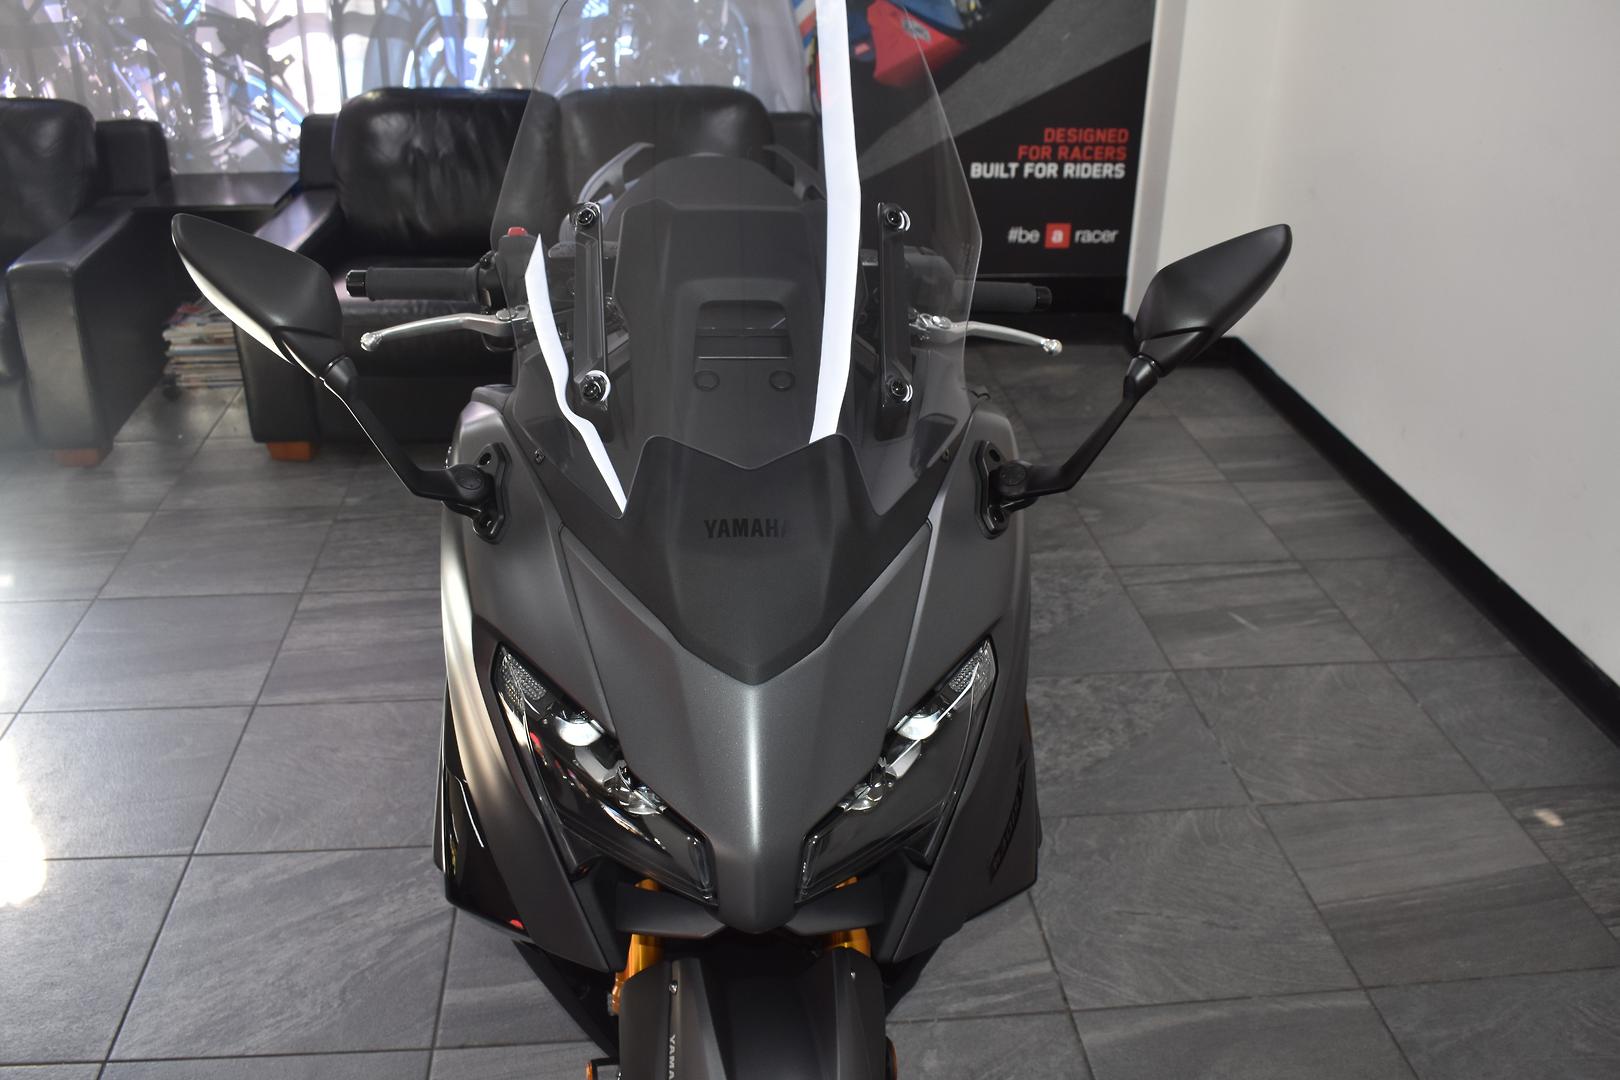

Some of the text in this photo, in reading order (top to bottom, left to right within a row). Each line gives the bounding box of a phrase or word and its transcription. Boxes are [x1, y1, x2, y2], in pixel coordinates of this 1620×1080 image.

[1044, 128, 1129, 143] DESIGNED
[1018, 146, 1127, 161] FOR RACERS
[970, 162, 1125, 179] BUILT FOR RIDERS
[1008, 226, 1040, 243] #be
[1074, 229, 1119, 243] racer
